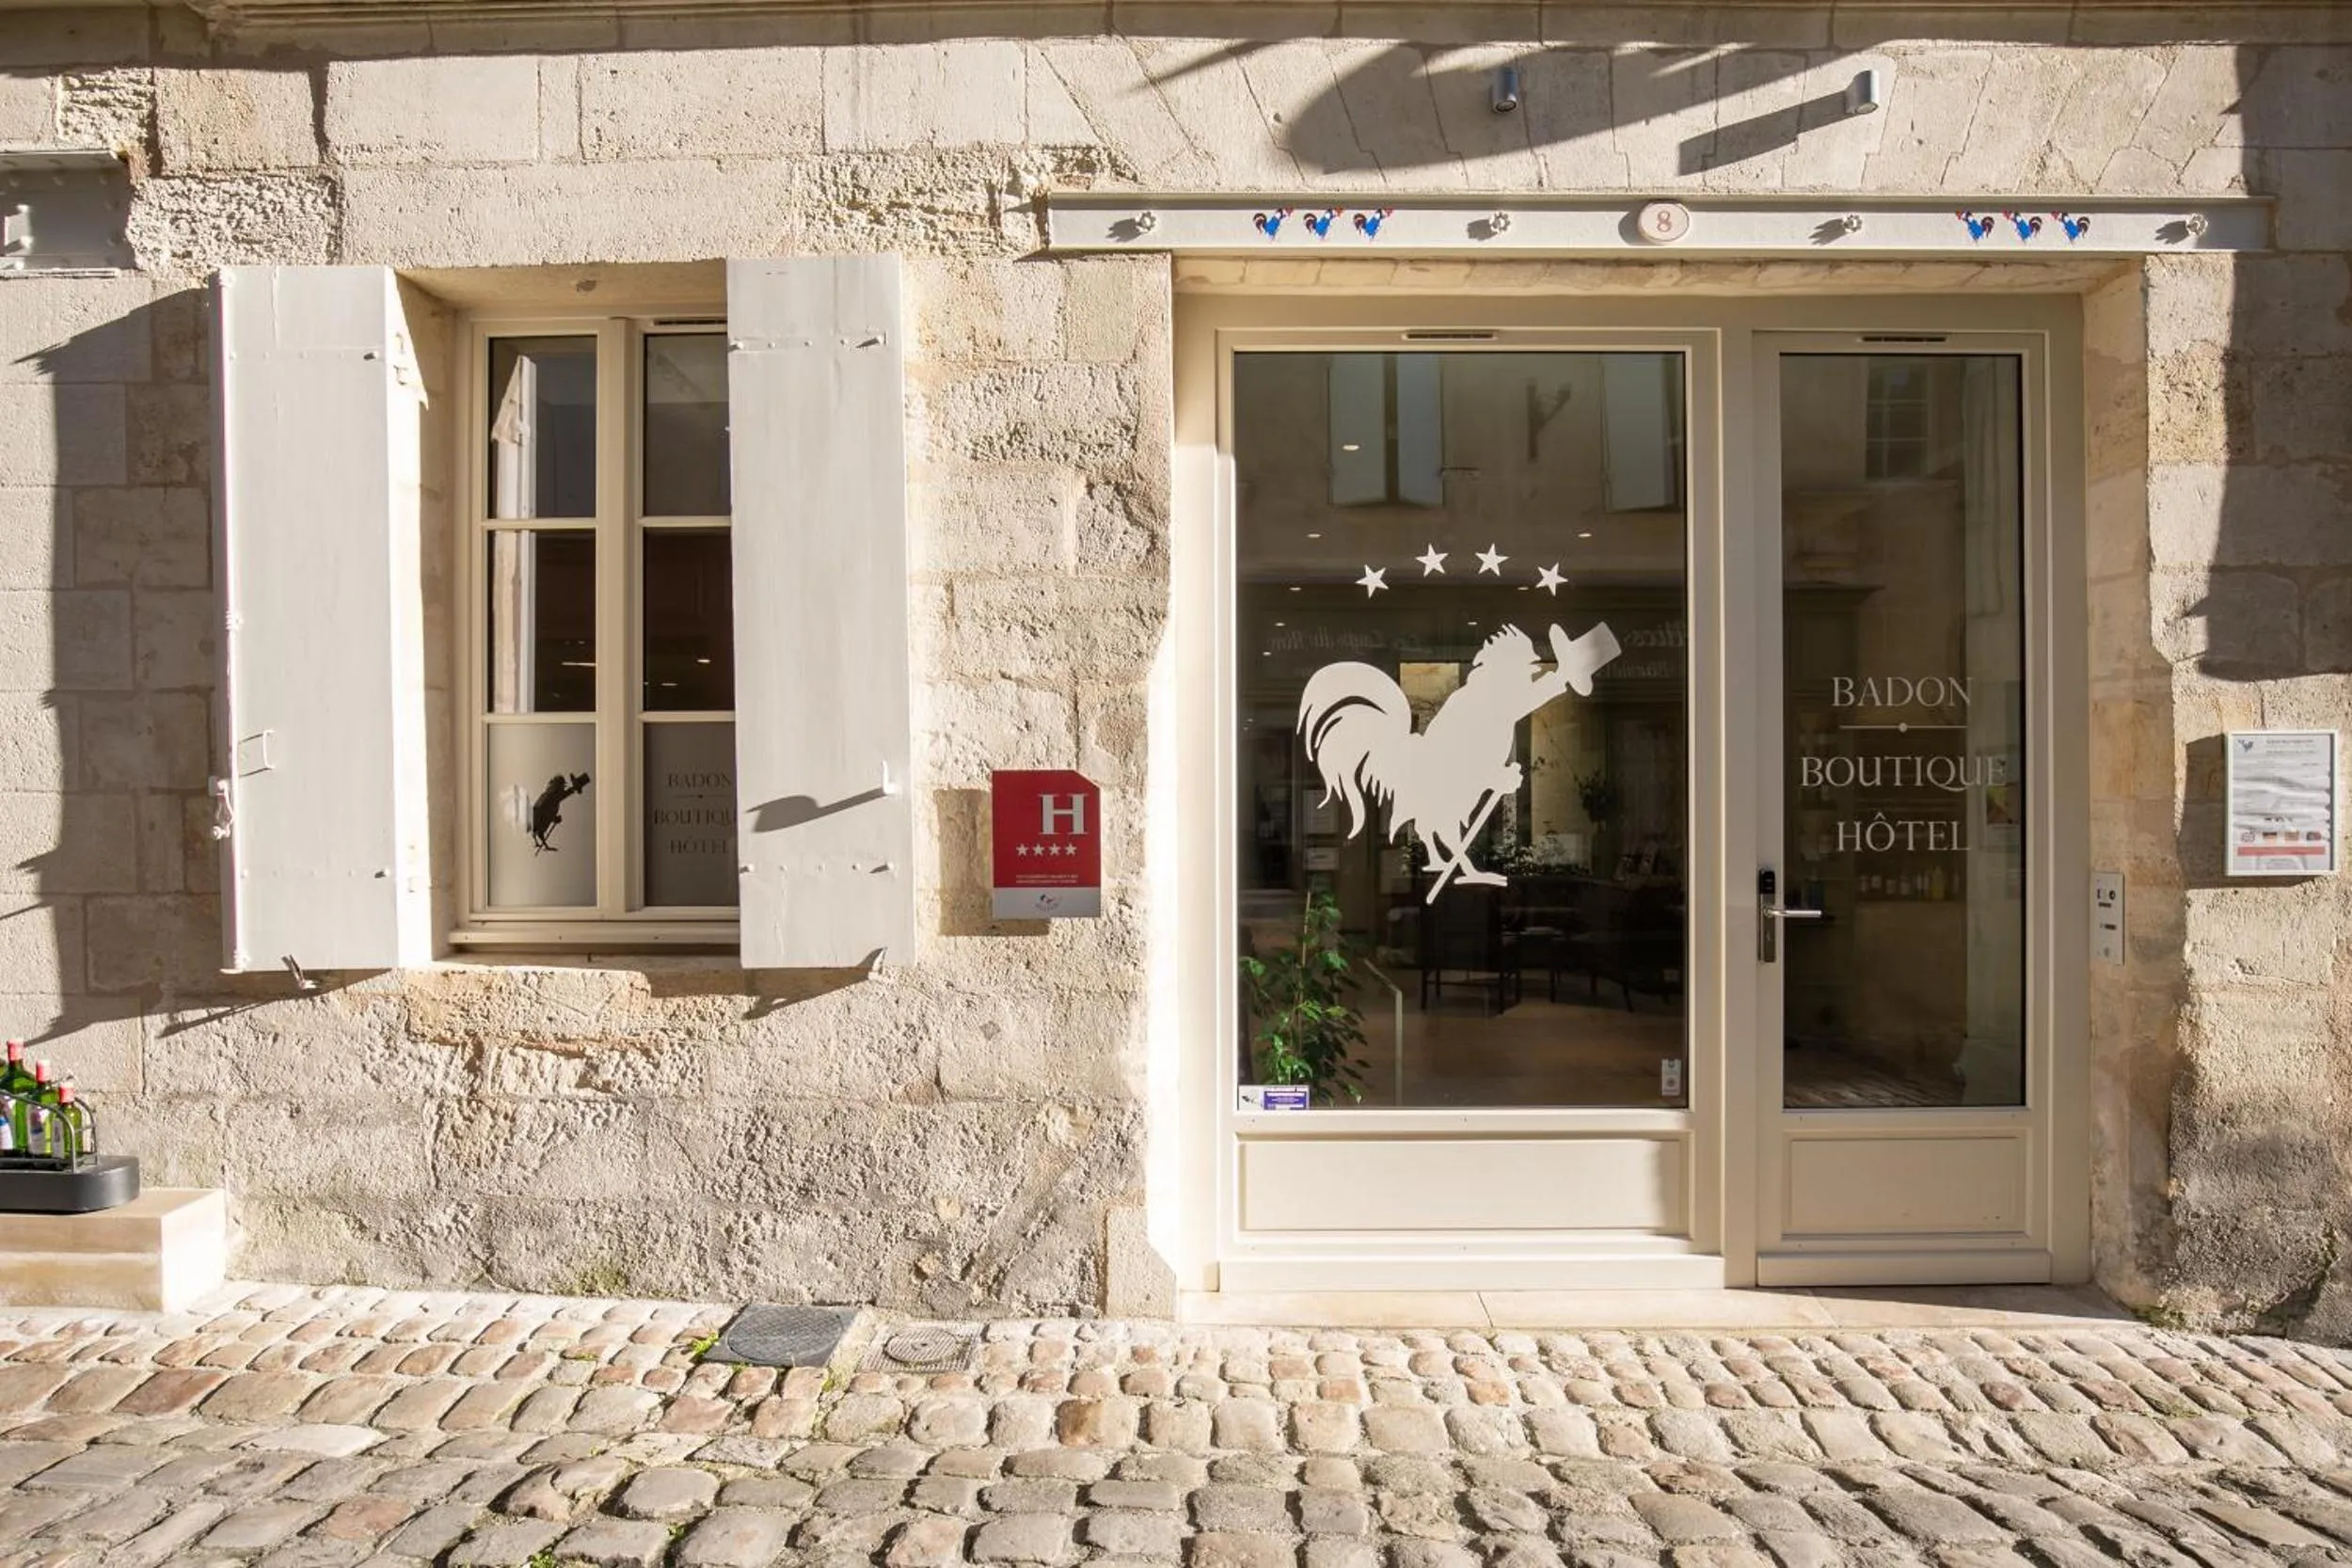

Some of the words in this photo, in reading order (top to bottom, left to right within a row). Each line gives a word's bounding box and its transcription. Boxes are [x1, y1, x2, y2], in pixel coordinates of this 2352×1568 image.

[1657, 210, 1672, 233] 8
[1831, 676, 1972, 707] BADON
[1800, 756, 2007, 792] BOUTIQUE
[1038, 793, 1089, 835] H
[1836, 812, 1973, 852] HÔTEL
